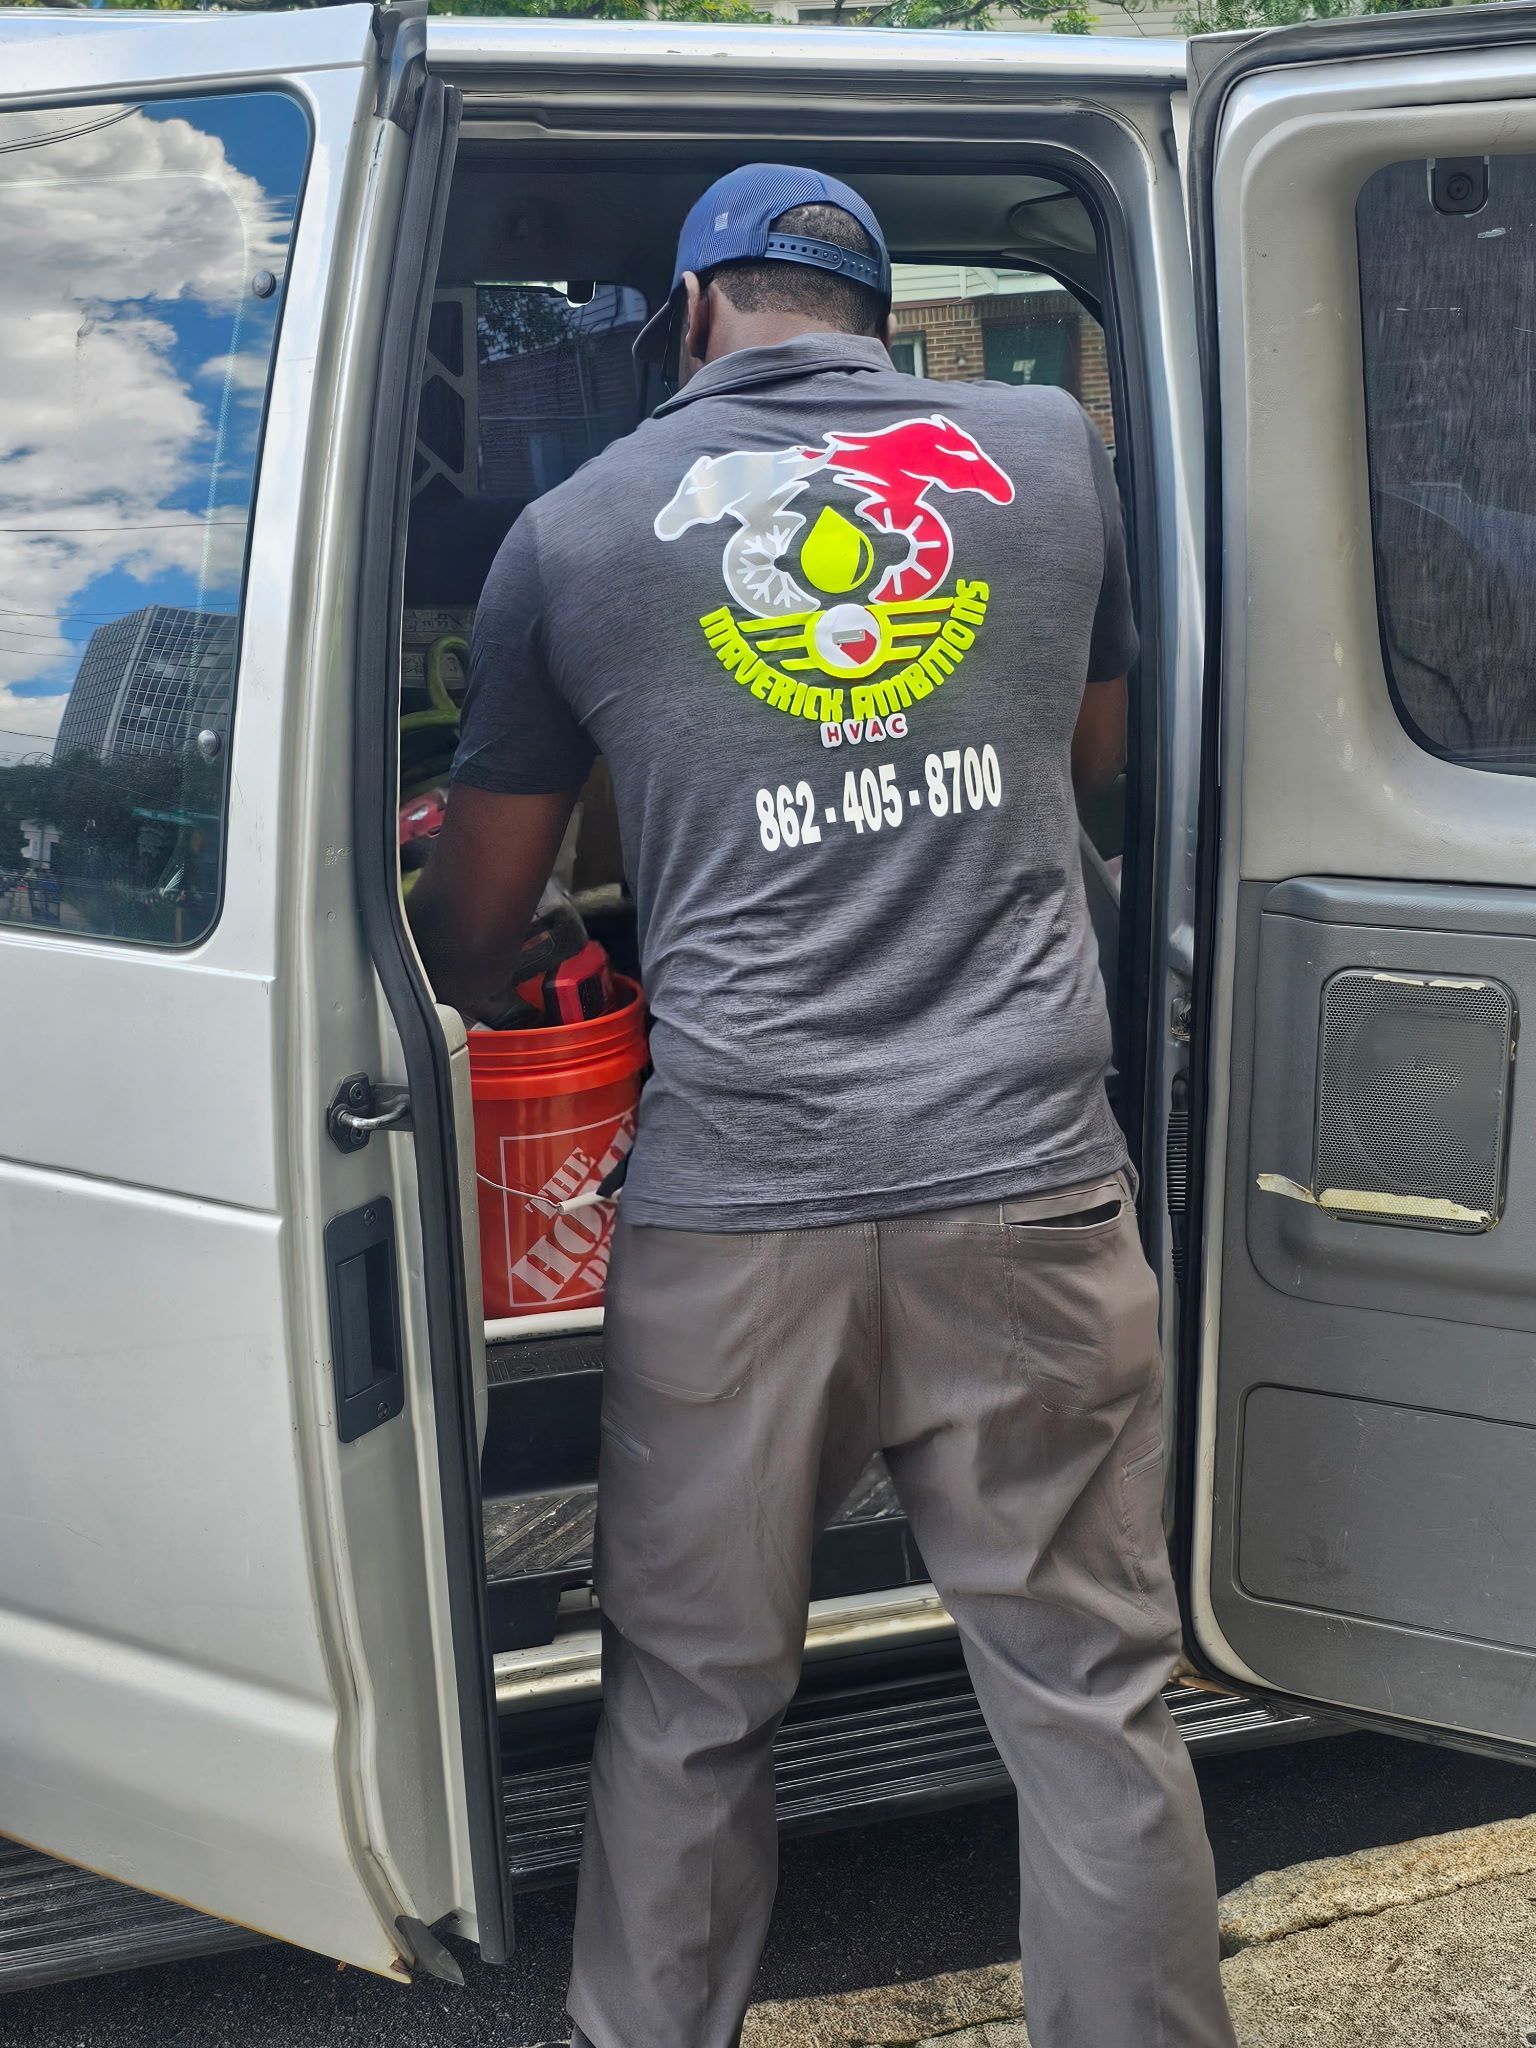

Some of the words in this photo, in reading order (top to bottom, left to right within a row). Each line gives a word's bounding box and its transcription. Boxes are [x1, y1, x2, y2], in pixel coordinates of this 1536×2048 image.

[700, 605, 843, 723] MAVERICK
[851, 579, 990, 720] AMBITIONS
[820, 714, 908, 748] HVAC
[525, 1147, 596, 1219] THE
